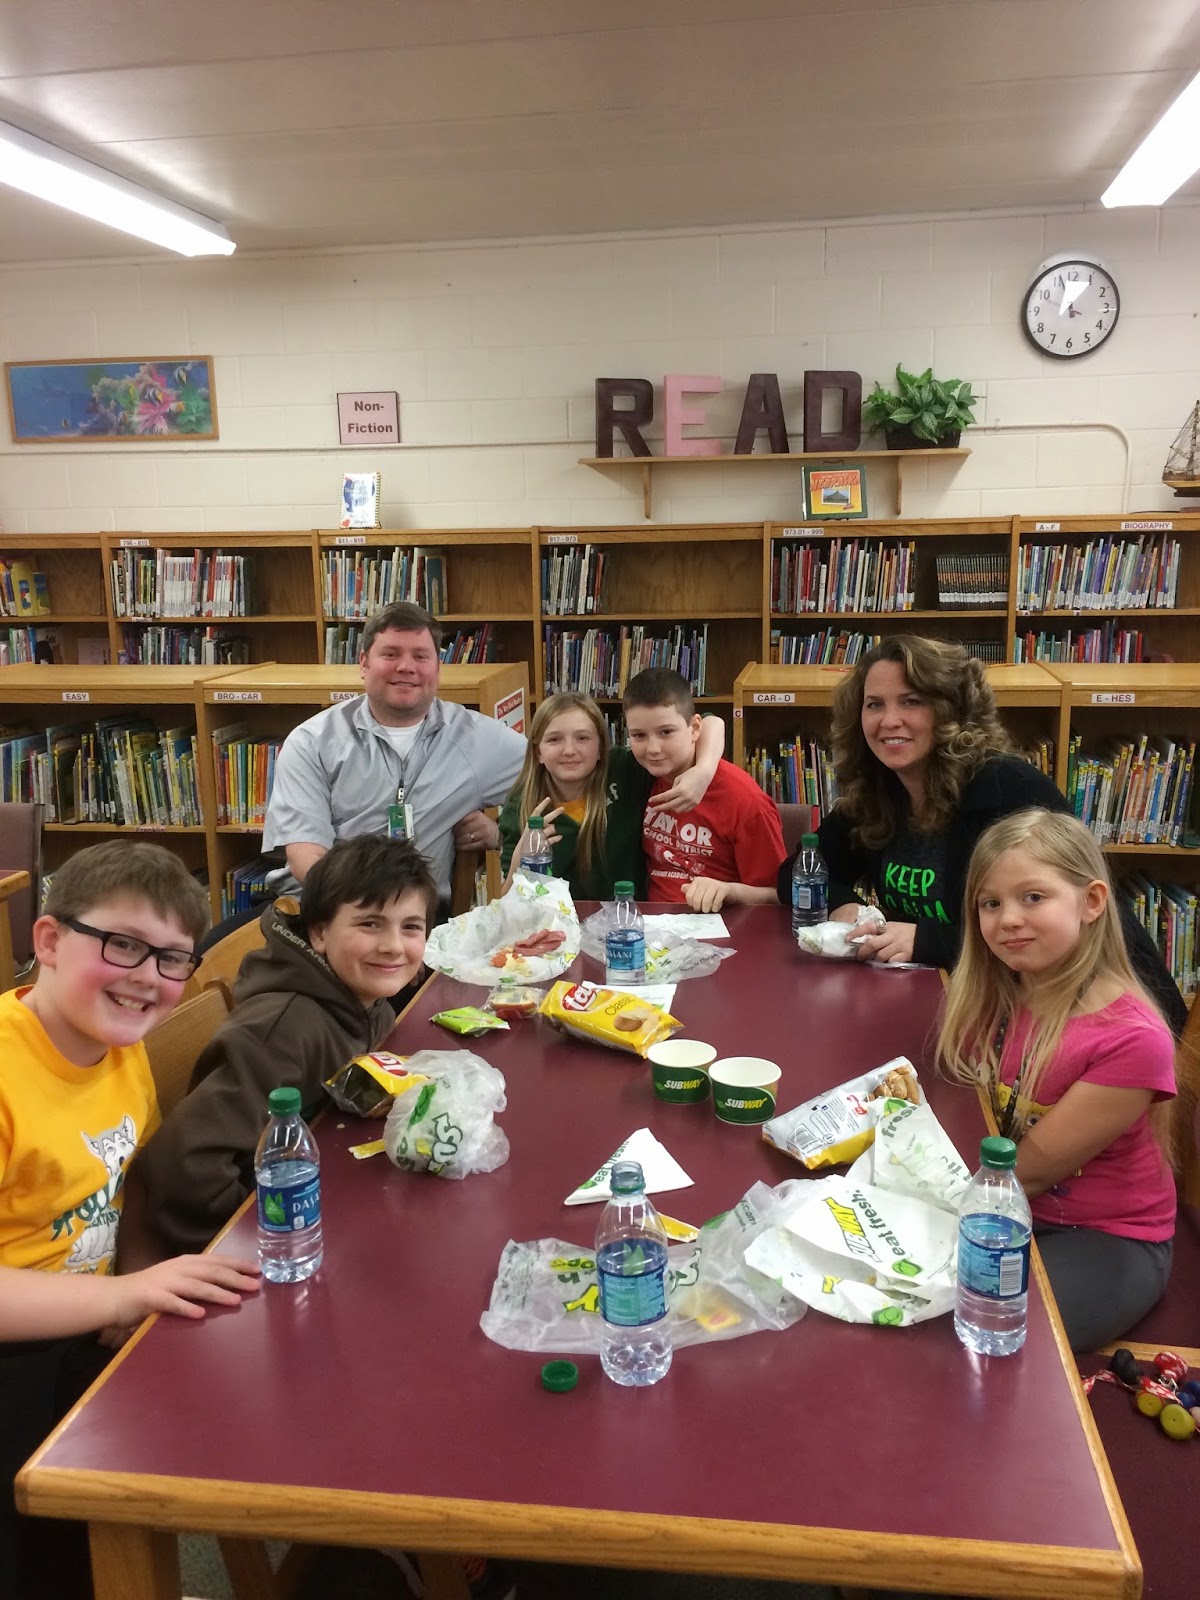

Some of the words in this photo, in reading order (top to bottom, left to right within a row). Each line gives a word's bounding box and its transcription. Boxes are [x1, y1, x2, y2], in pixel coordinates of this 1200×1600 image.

[1067, 271, 1079, 282] 12
[1087, 274, 1093, 286] 1
[1039, 289, 1051, 301] 10
[1098, 286, 1106, 298] 2
[1033, 306, 1040, 317] 9
[1103, 302, 1110, 314] 3
[1037, 322, 1044, 333] 8
[1095, 319, 1103, 331] 4
[1049, 333, 1057, 345] 7
[1065, 338, 1073, 349] 6
[1083, 332, 1091, 344] 5
[354, 401, 385, 412] Non-
[596, 370, 863, 458] READ
[347, 423, 393, 433] Fiction
[66, 693, 87, 701] EASY
[333, 692, 355, 700] EASY
[757, 694, 776, 702] CAR
[784, 694, 791, 702] D
[1096, 694, 1102, 702] E
[1111, 694, 1132, 702] HES
[734, 710, 741, 718] C
[643, 826, 674, 847] CHOOL
[885, 862, 936, 897] KEEP
[272, 922, 307, 949] UNDER
[608, 949, 632, 959] ASANI
[664, 1078, 705, 1090] SUBWAY
[725, 1097, 768, 1110] SUBWAY
[594, 1166, 611, 1182] eat
[878, 1230, 906, 1257] eat
